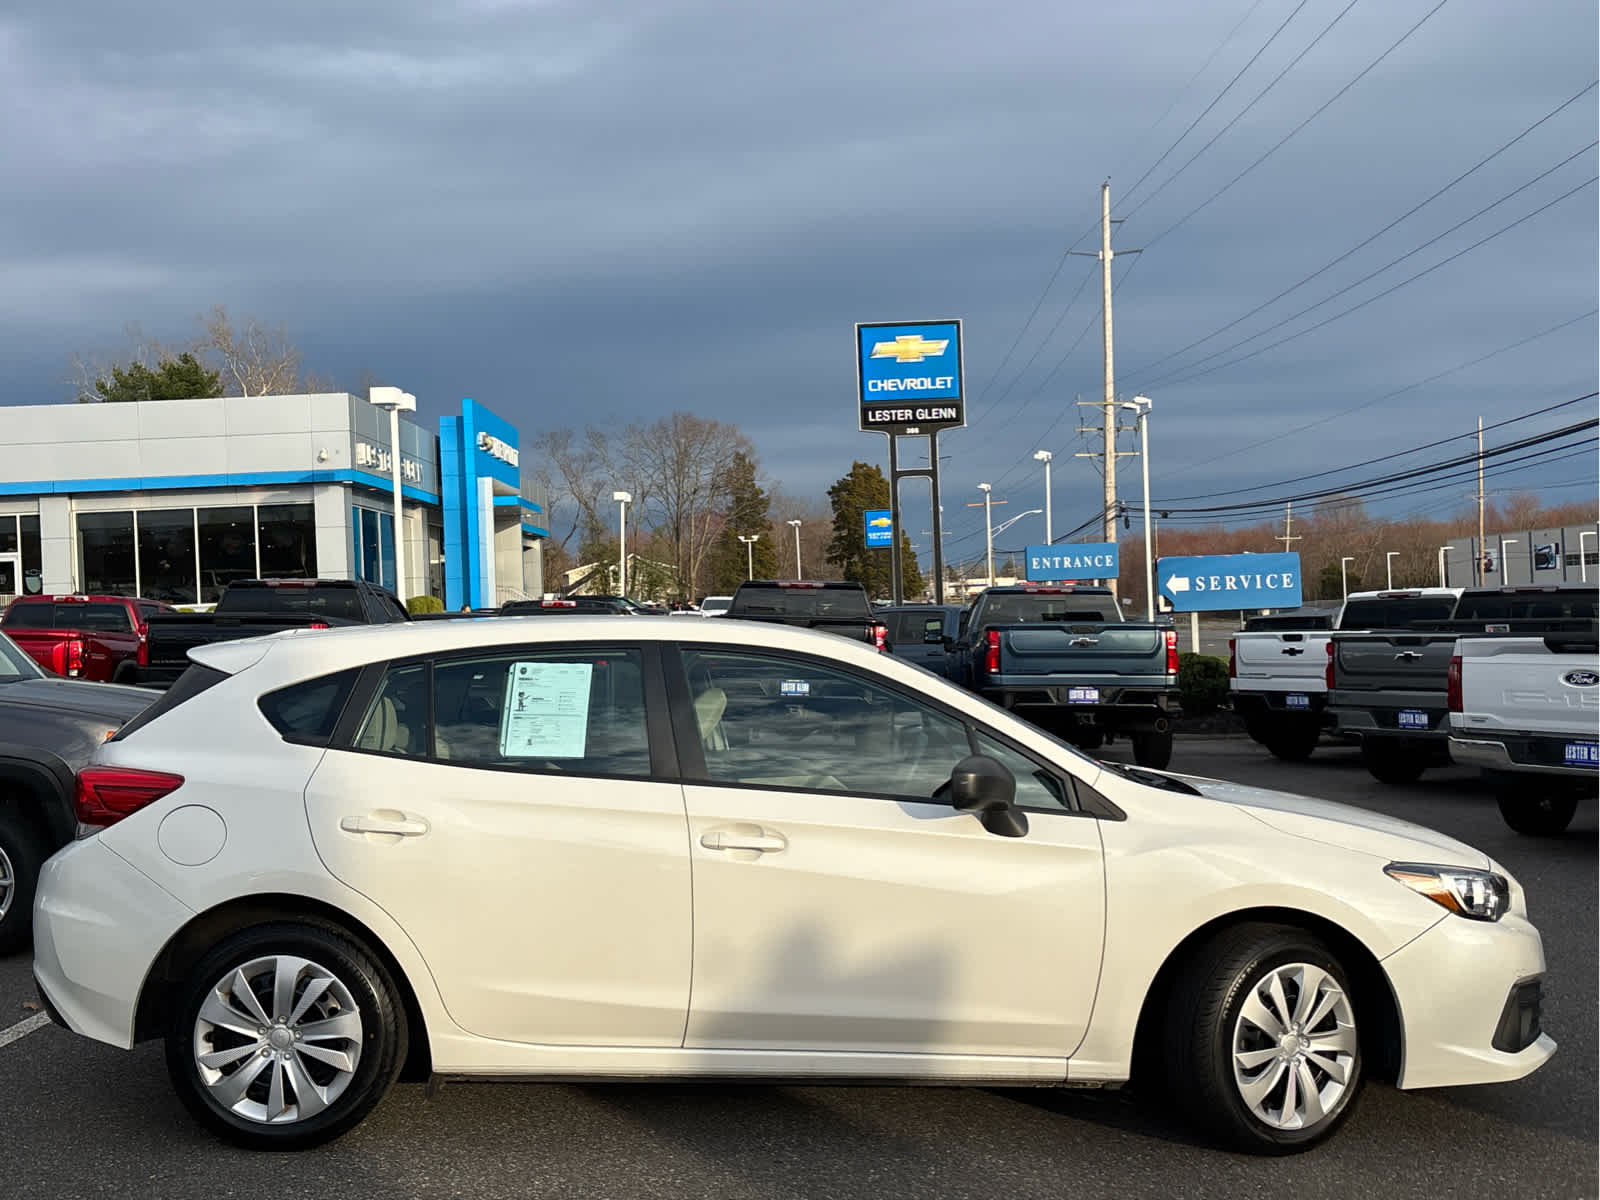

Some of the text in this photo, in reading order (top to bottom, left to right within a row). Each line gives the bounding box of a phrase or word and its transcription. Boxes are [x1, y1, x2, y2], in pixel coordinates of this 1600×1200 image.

[868, 377, 954, 392] CHEVROLET
[868, 407, 957, 422] LESTER GLENN
[1031, 554, 1115, 570] ENTRANCE
[1195, 573, 1295, 592] SERVICE
[1565, 744, 1588, 760] LESTER
